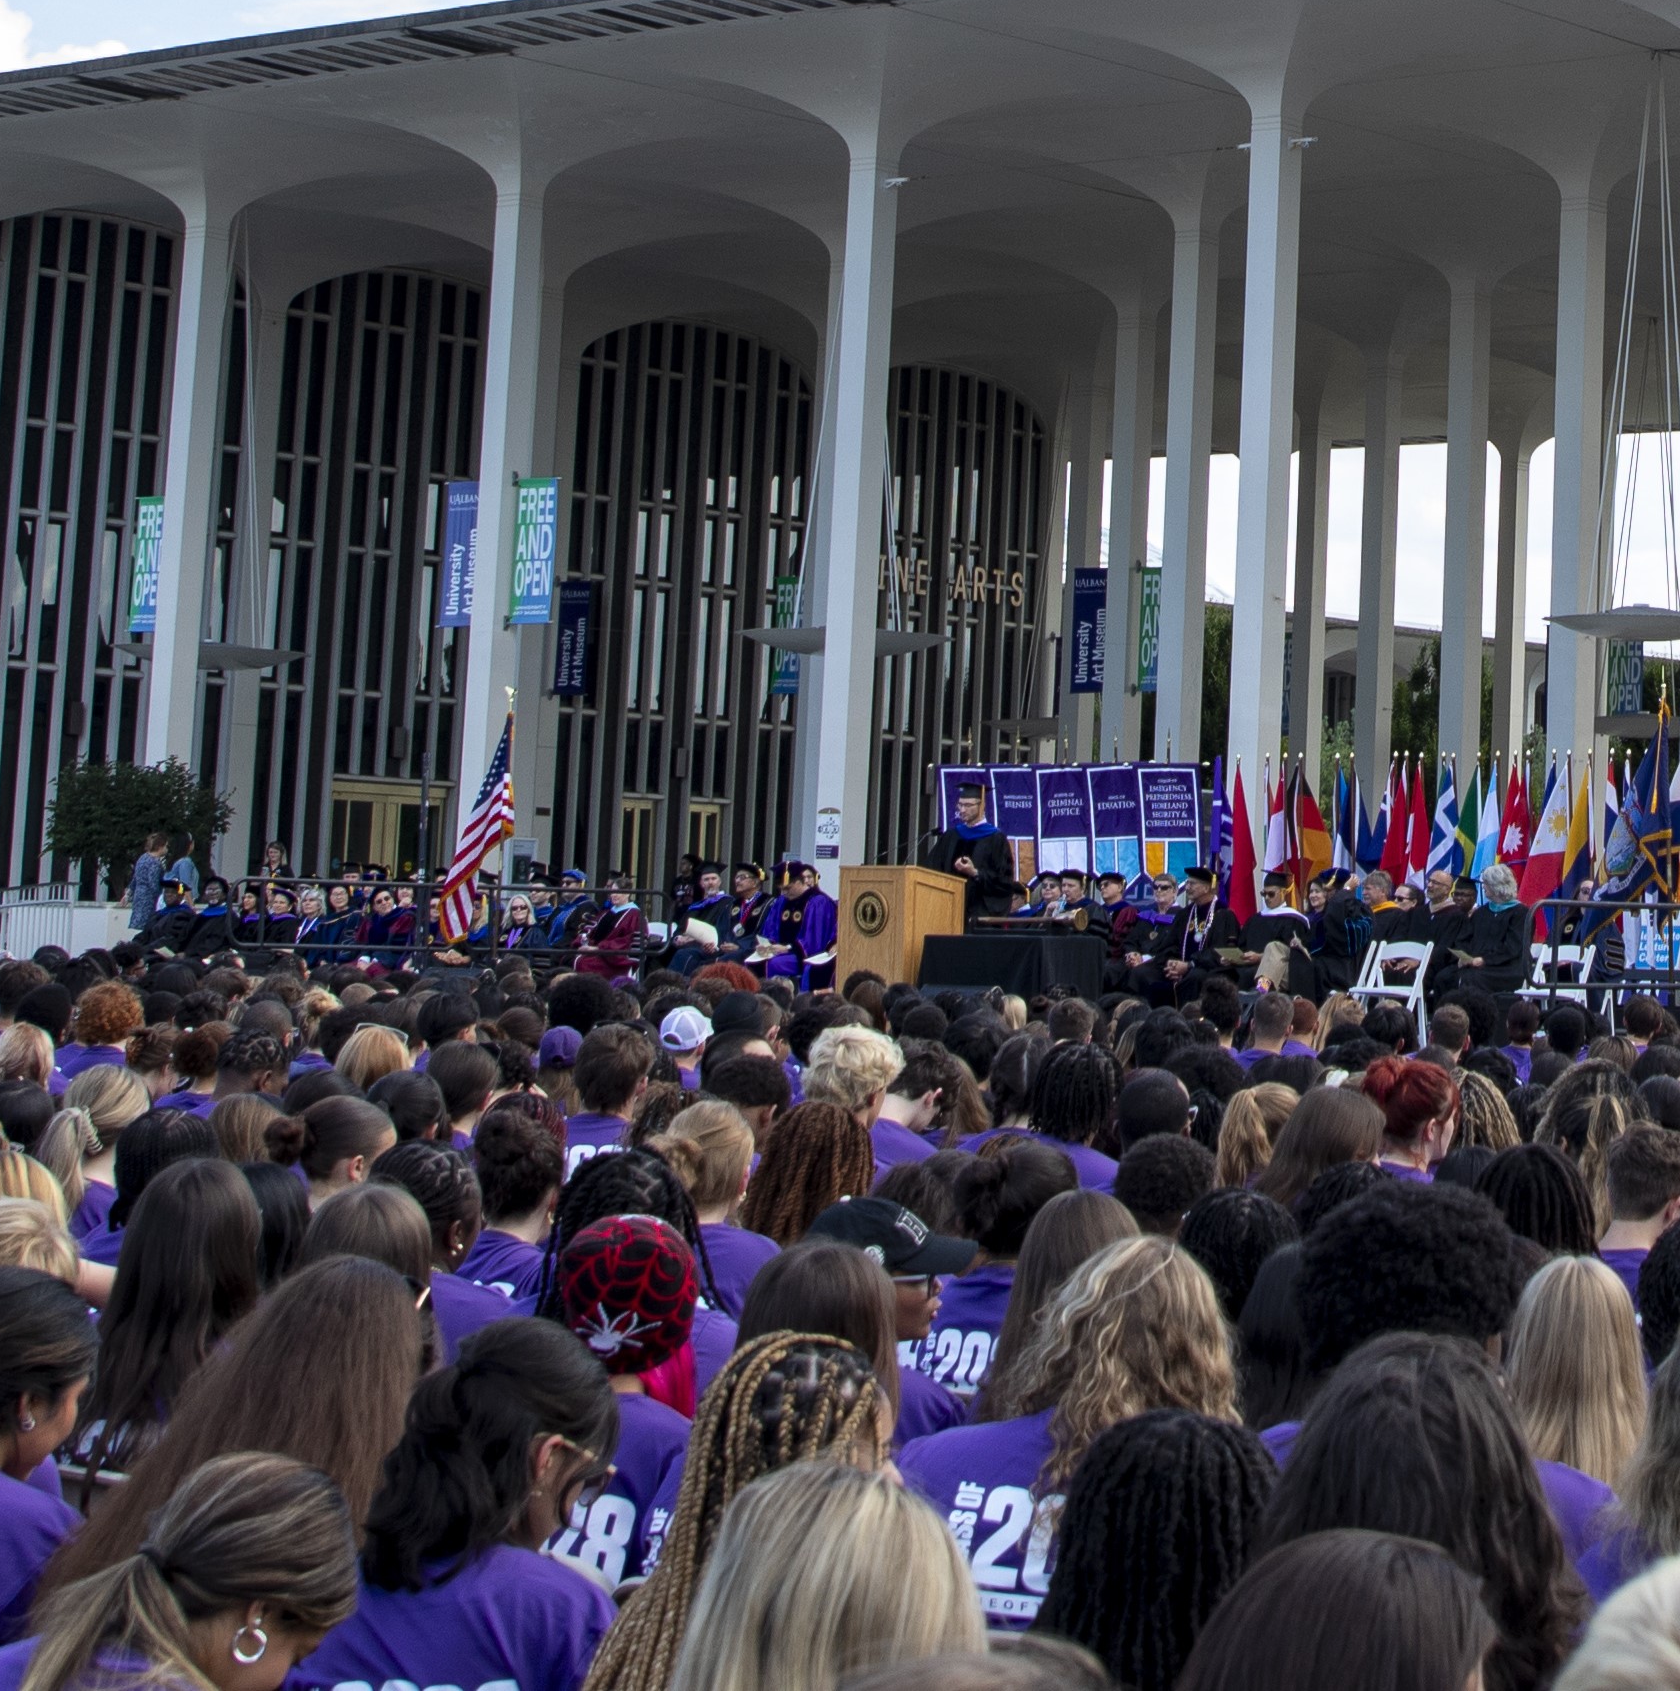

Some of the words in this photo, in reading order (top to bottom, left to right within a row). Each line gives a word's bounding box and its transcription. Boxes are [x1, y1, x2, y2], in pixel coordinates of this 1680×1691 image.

[450, 493, 480, 507] UALBAN
[518, 487, 555, 524] FREE
[138, 505, 164, 538] FRE
[136, 539, 162, 572] AN
[516, 525, 554, 560] AND
[133, 573, 158, 607] OPE
[445, 543, 466, 616] University
[514, 561, 552, 597] OPEN
[878, 555, 929, 595] INE
[952, 564, 1024, 607] ARTS
[1075, 577, 1107, 589] UALBAN
[1143, 574, 1161, 605] FR
[574, 617, 587, 666] Museum
[1092, 608, 1106, 660] Museum
[558, 629, 574, 687] University
[1074, 621, 1093, 684] University
[1141, 637, 1158, 668] OP
[571, 669, 583, 687] Art
[1609, 657, 1642, 684] AND
[1609, 684, 1641, 712] OPEN
[1047, 798, 1084, 807] CRIMINAL
[1051, 808, 1080, 817] JUSTICE
[954, 1480, 986, 1509] OF
[972, 1484, 1070, 1593] 20
